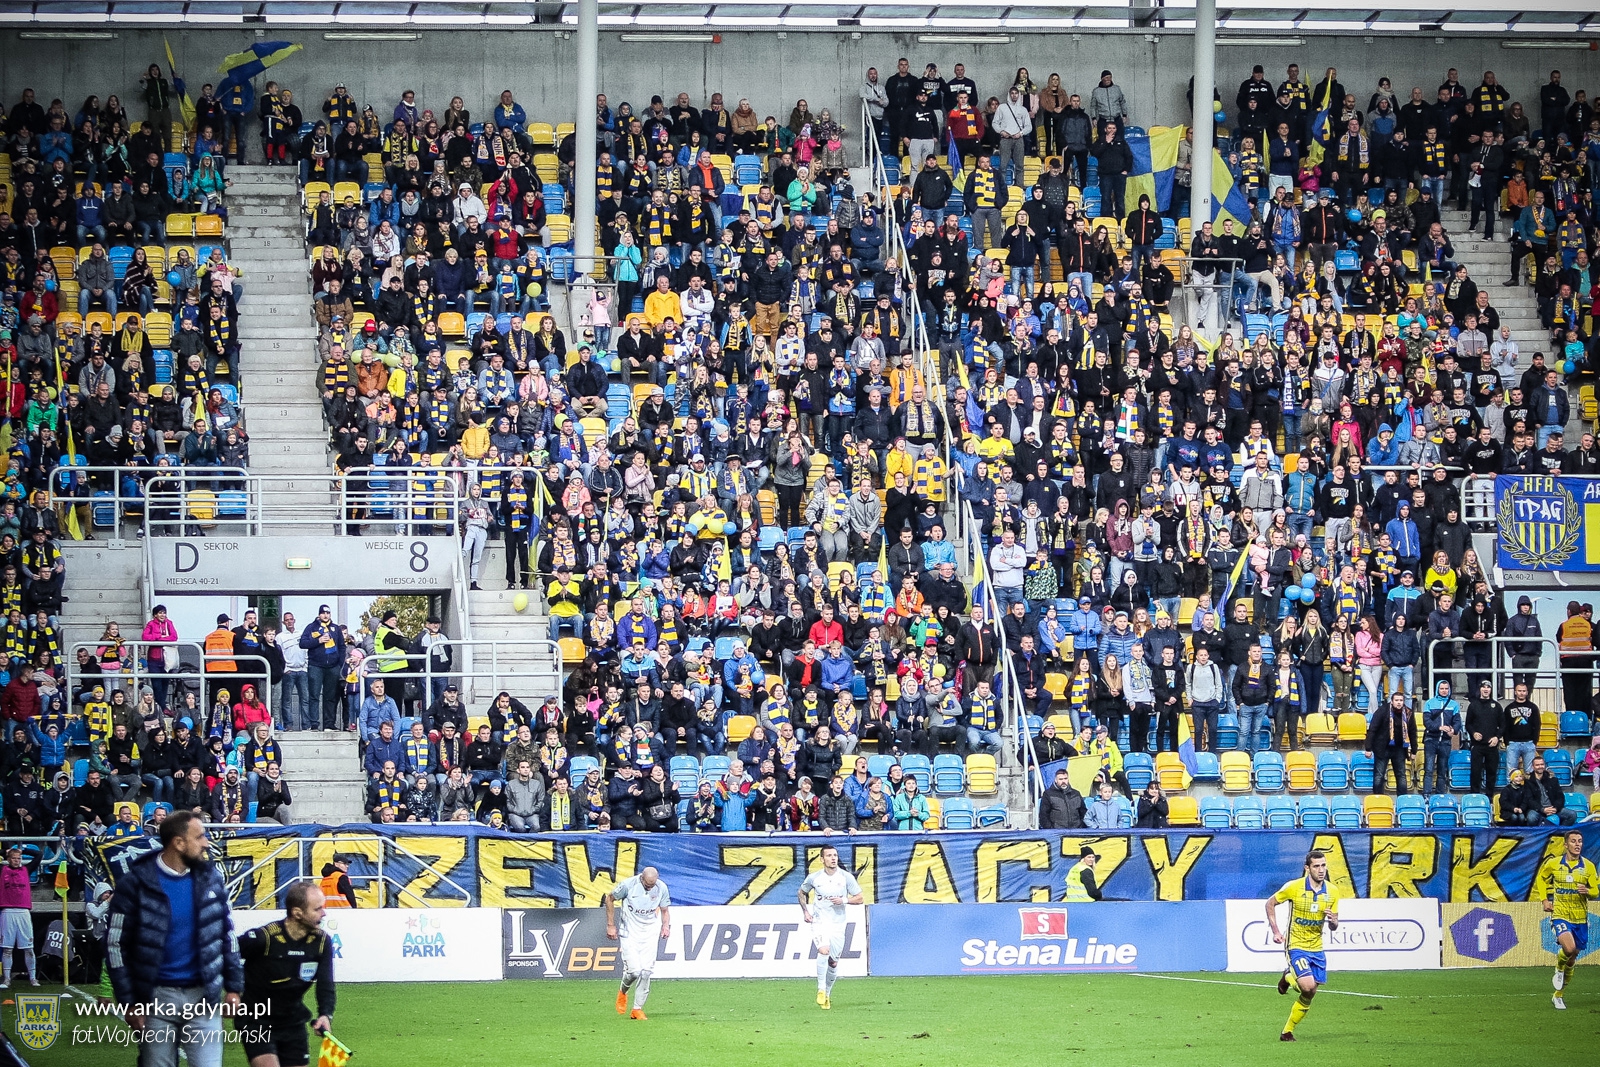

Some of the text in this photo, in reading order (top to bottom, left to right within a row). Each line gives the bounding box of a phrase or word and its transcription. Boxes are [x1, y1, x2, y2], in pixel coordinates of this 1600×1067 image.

[1524, 477, 1554, 492] HFA
[1514, 498, 1563, 522] TPAG
[175, 542, 240, 573] D SEKTOR
[364, 540, 429, 572] WEJŚCIE 8
[226, 831, 641, 909] TCZEW
[1038, 914, 1050, 932] S
[1556, 923, 1568, 933] 33
[403, 932, 445, 944] AQUA
[508, 910, 622, 978] LV BE
[656, 922, 862, 962] LVBET.L
[403, 945, 445, 957] PARK
[960, 938, 1138, 966] Stena Line
[1295, 958, 1310, 971] 10
